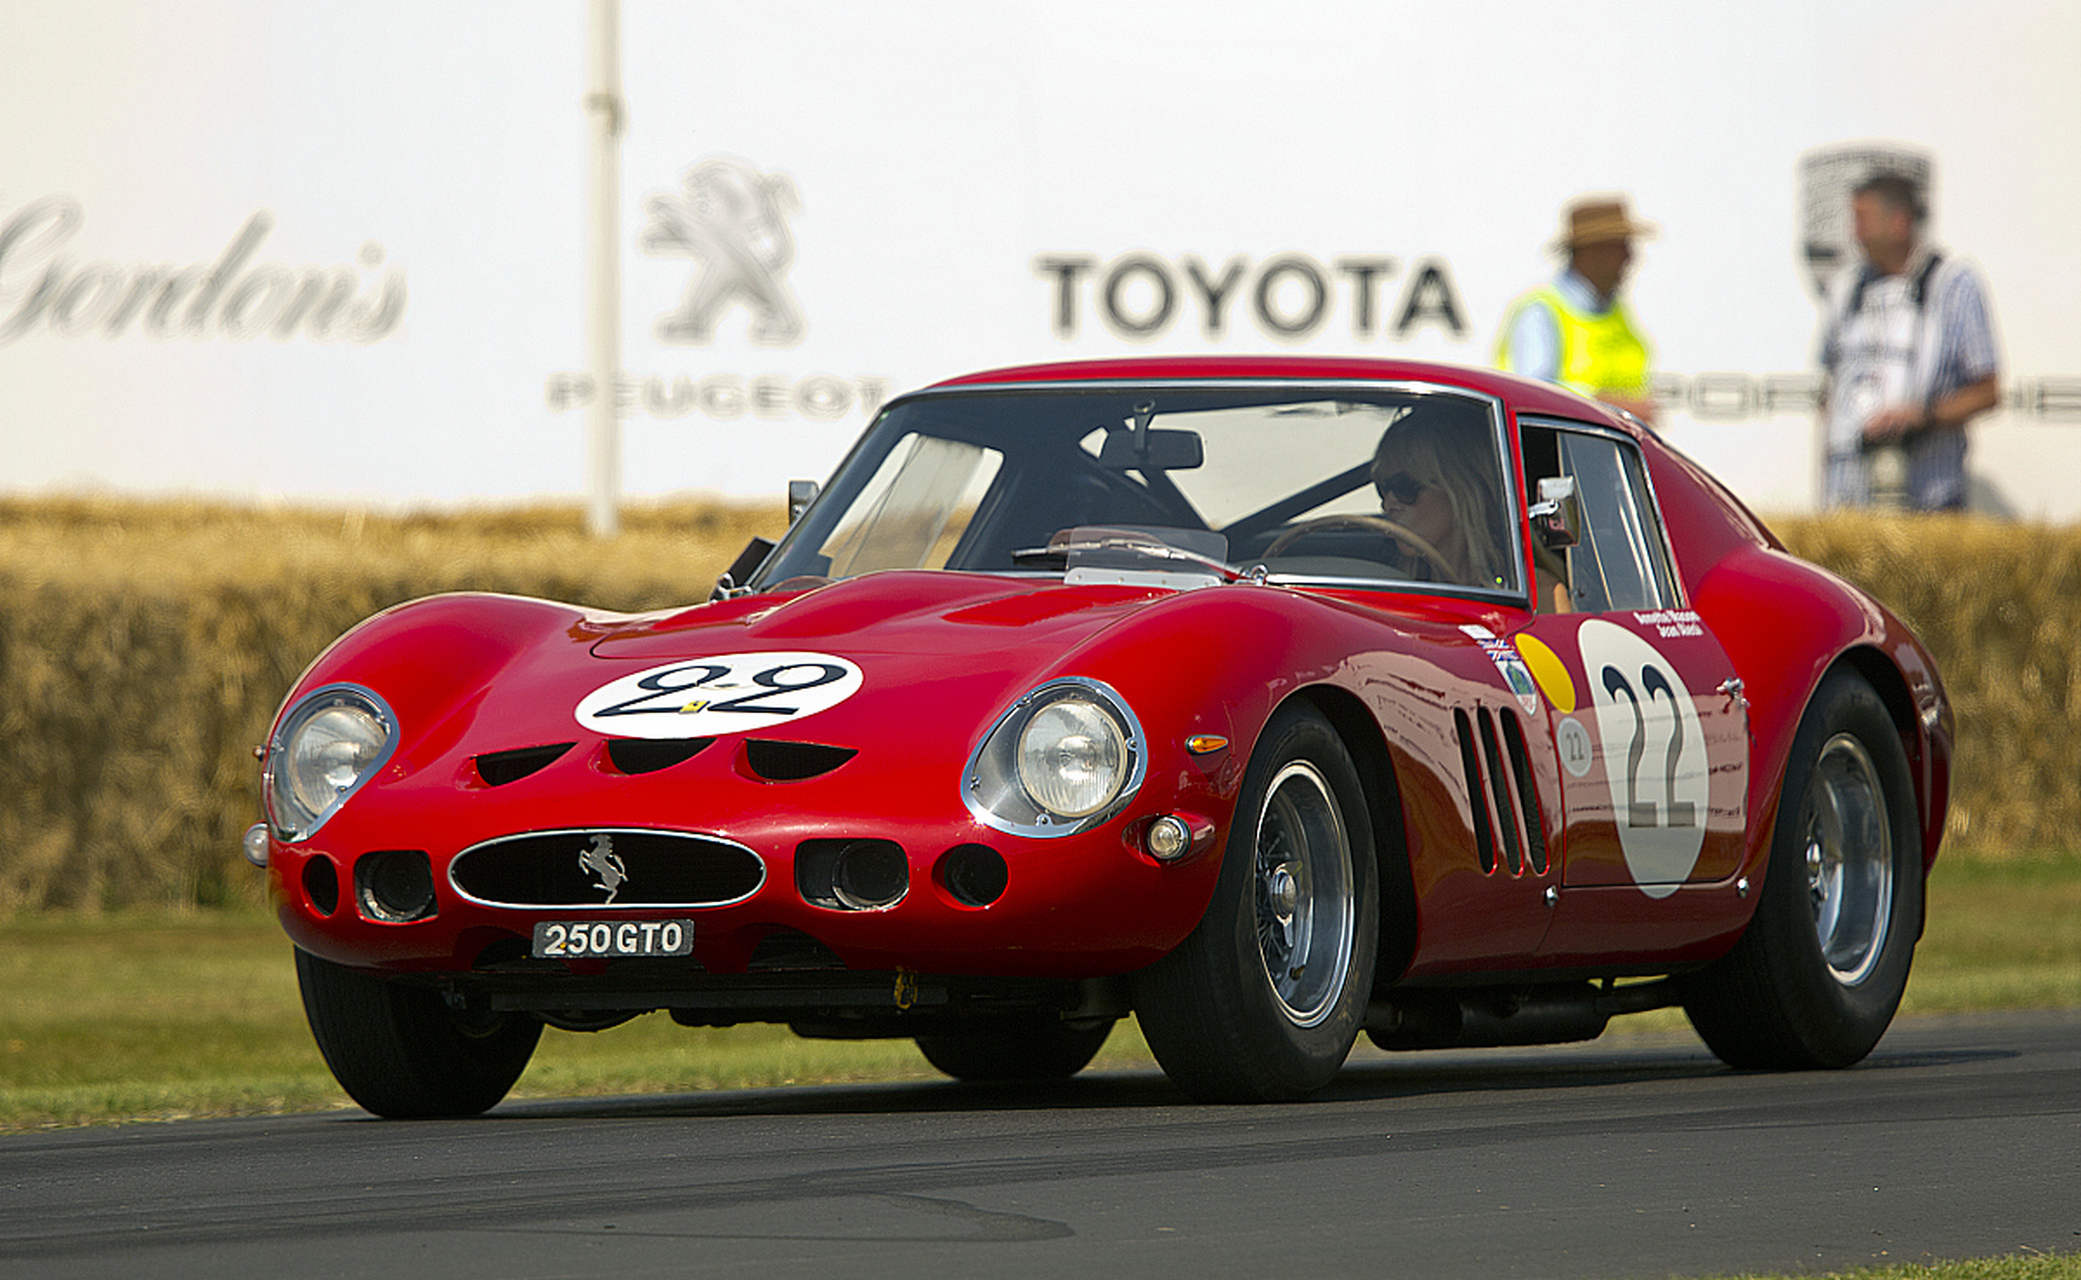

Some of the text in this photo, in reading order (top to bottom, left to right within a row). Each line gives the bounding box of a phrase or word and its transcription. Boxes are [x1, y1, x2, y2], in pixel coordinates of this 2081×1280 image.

[0, 194, 408, 346] Gordon's
[1034, 252, 1470, 338] TOYOTA
[592, 663, 848, 718] 22
[1601, 664, 1696, 828] 22
